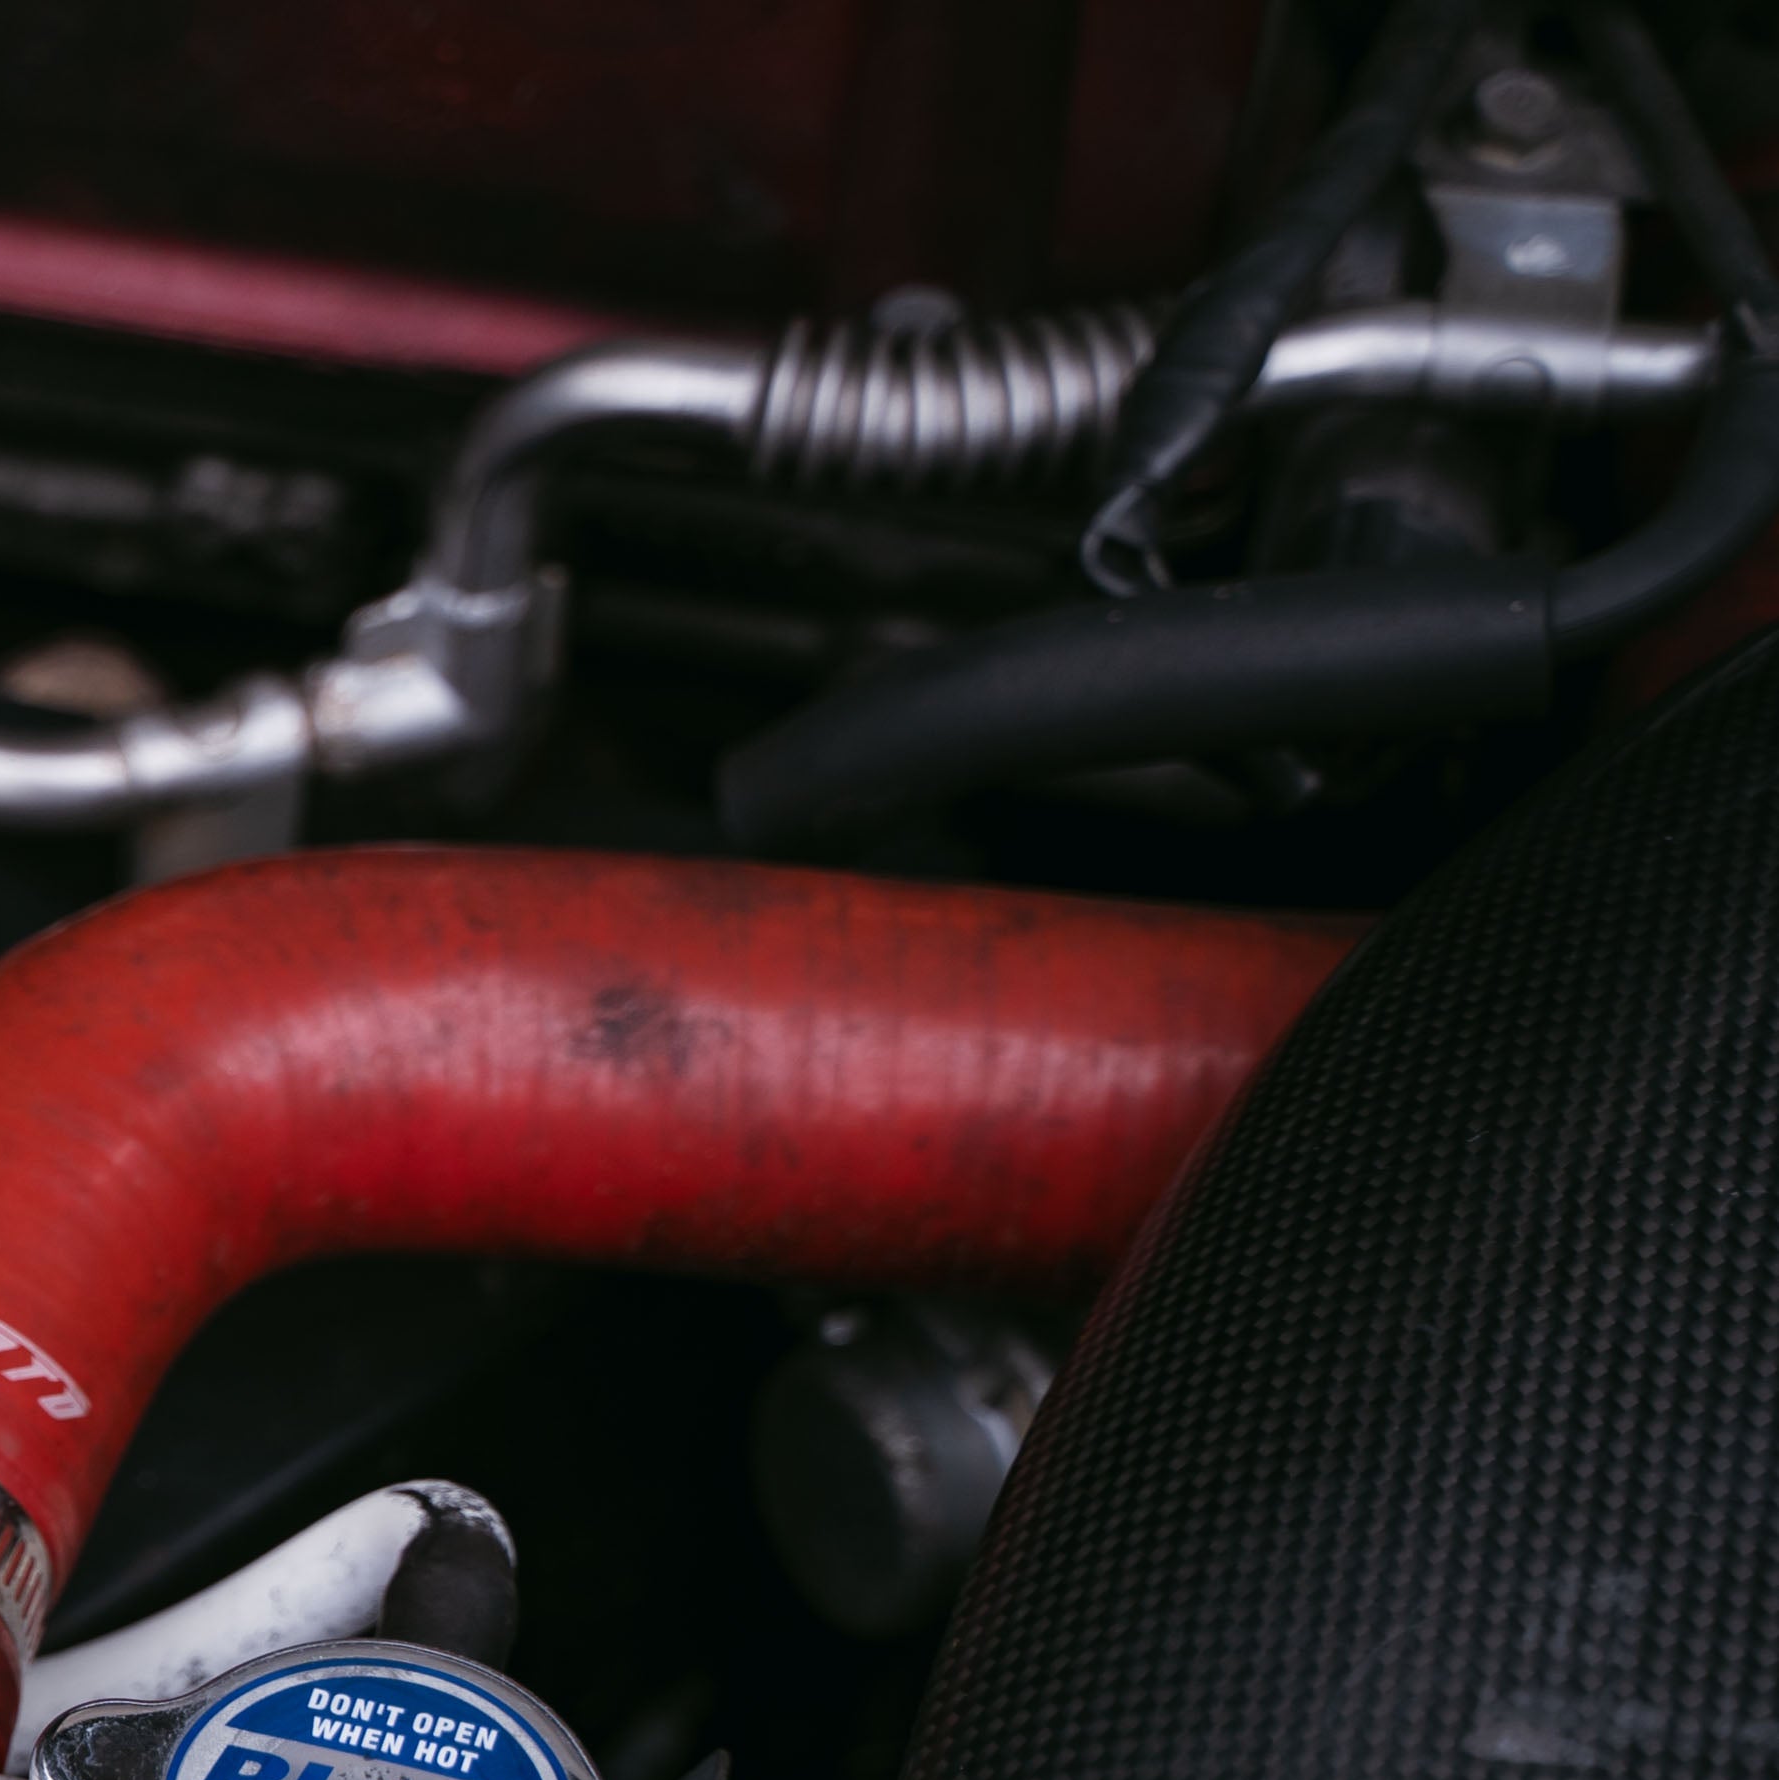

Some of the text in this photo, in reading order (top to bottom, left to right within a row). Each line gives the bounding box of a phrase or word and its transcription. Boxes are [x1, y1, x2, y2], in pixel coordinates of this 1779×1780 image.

[308, 1688, 499, 1752] DON'T OPEN
[311, 1715, 480, 1774] WHEN HOT
